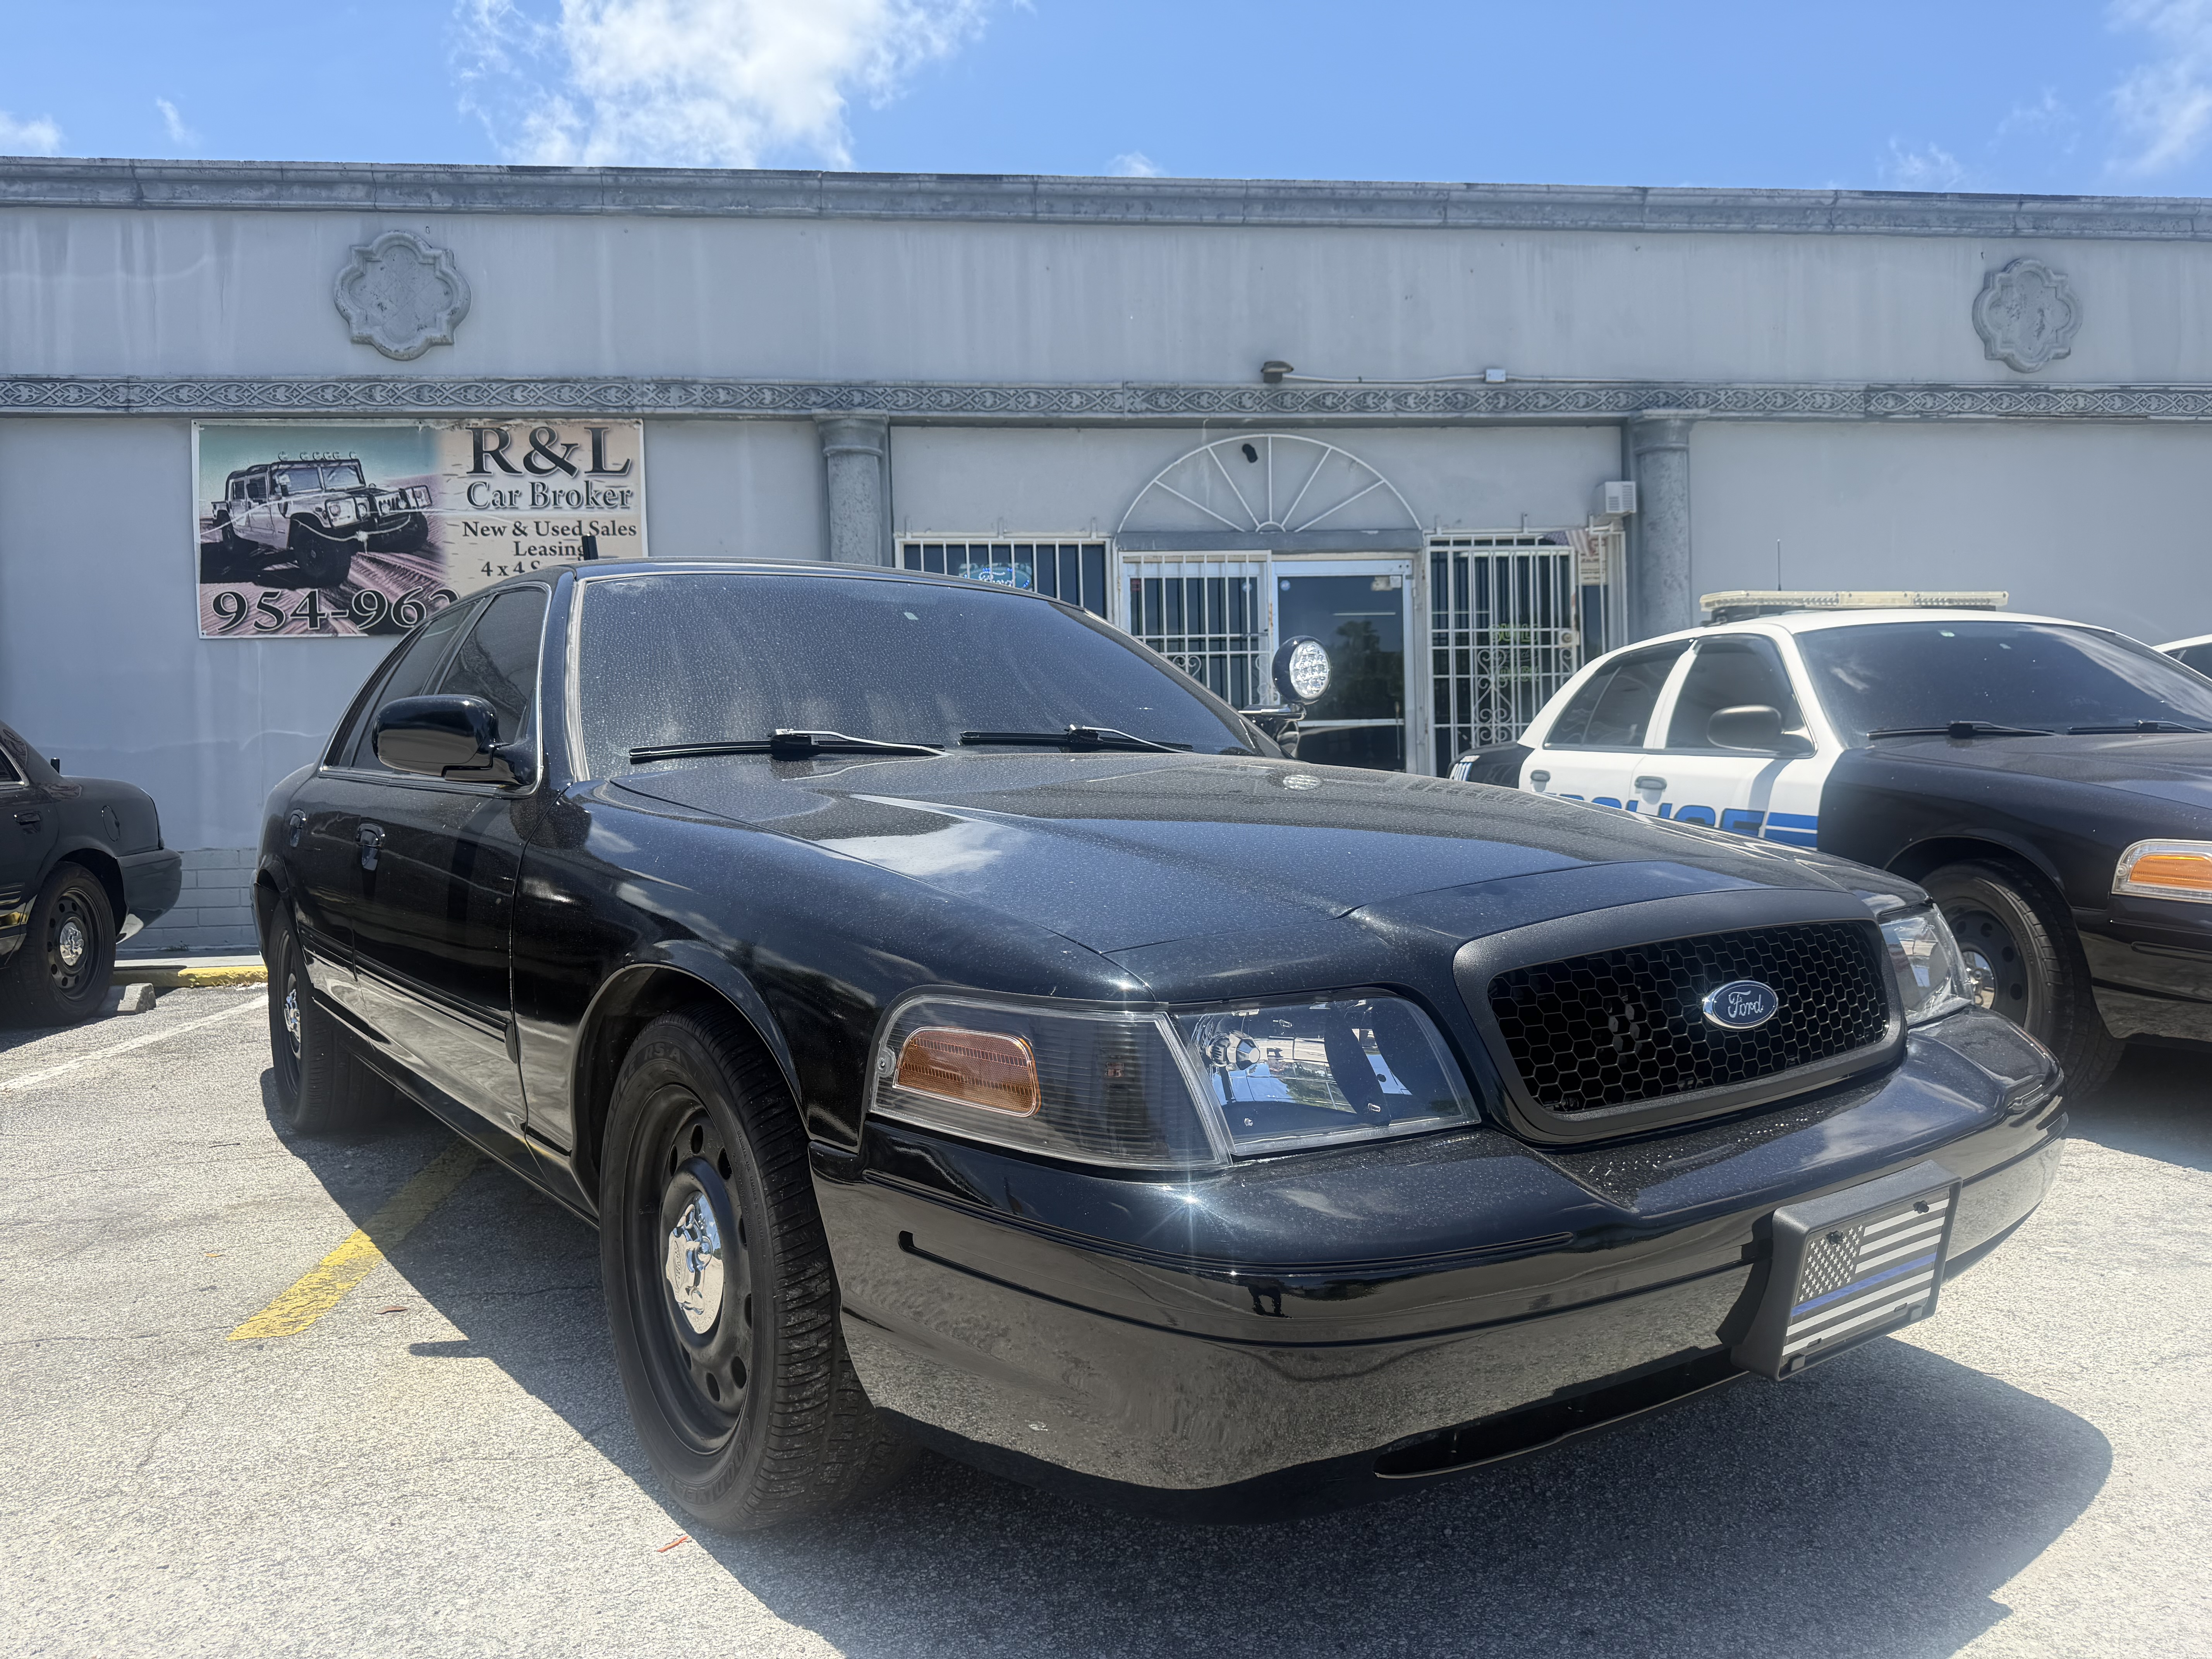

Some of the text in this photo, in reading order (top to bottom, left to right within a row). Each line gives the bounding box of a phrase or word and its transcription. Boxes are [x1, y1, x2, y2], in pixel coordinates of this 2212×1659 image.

[465, 426, 632, 478] R&L
[466, 479, 634, 509] Car Broker
[462, 520, 637, 537] New & Used Sales
[1728, 990, 1764, 1018] Ford
